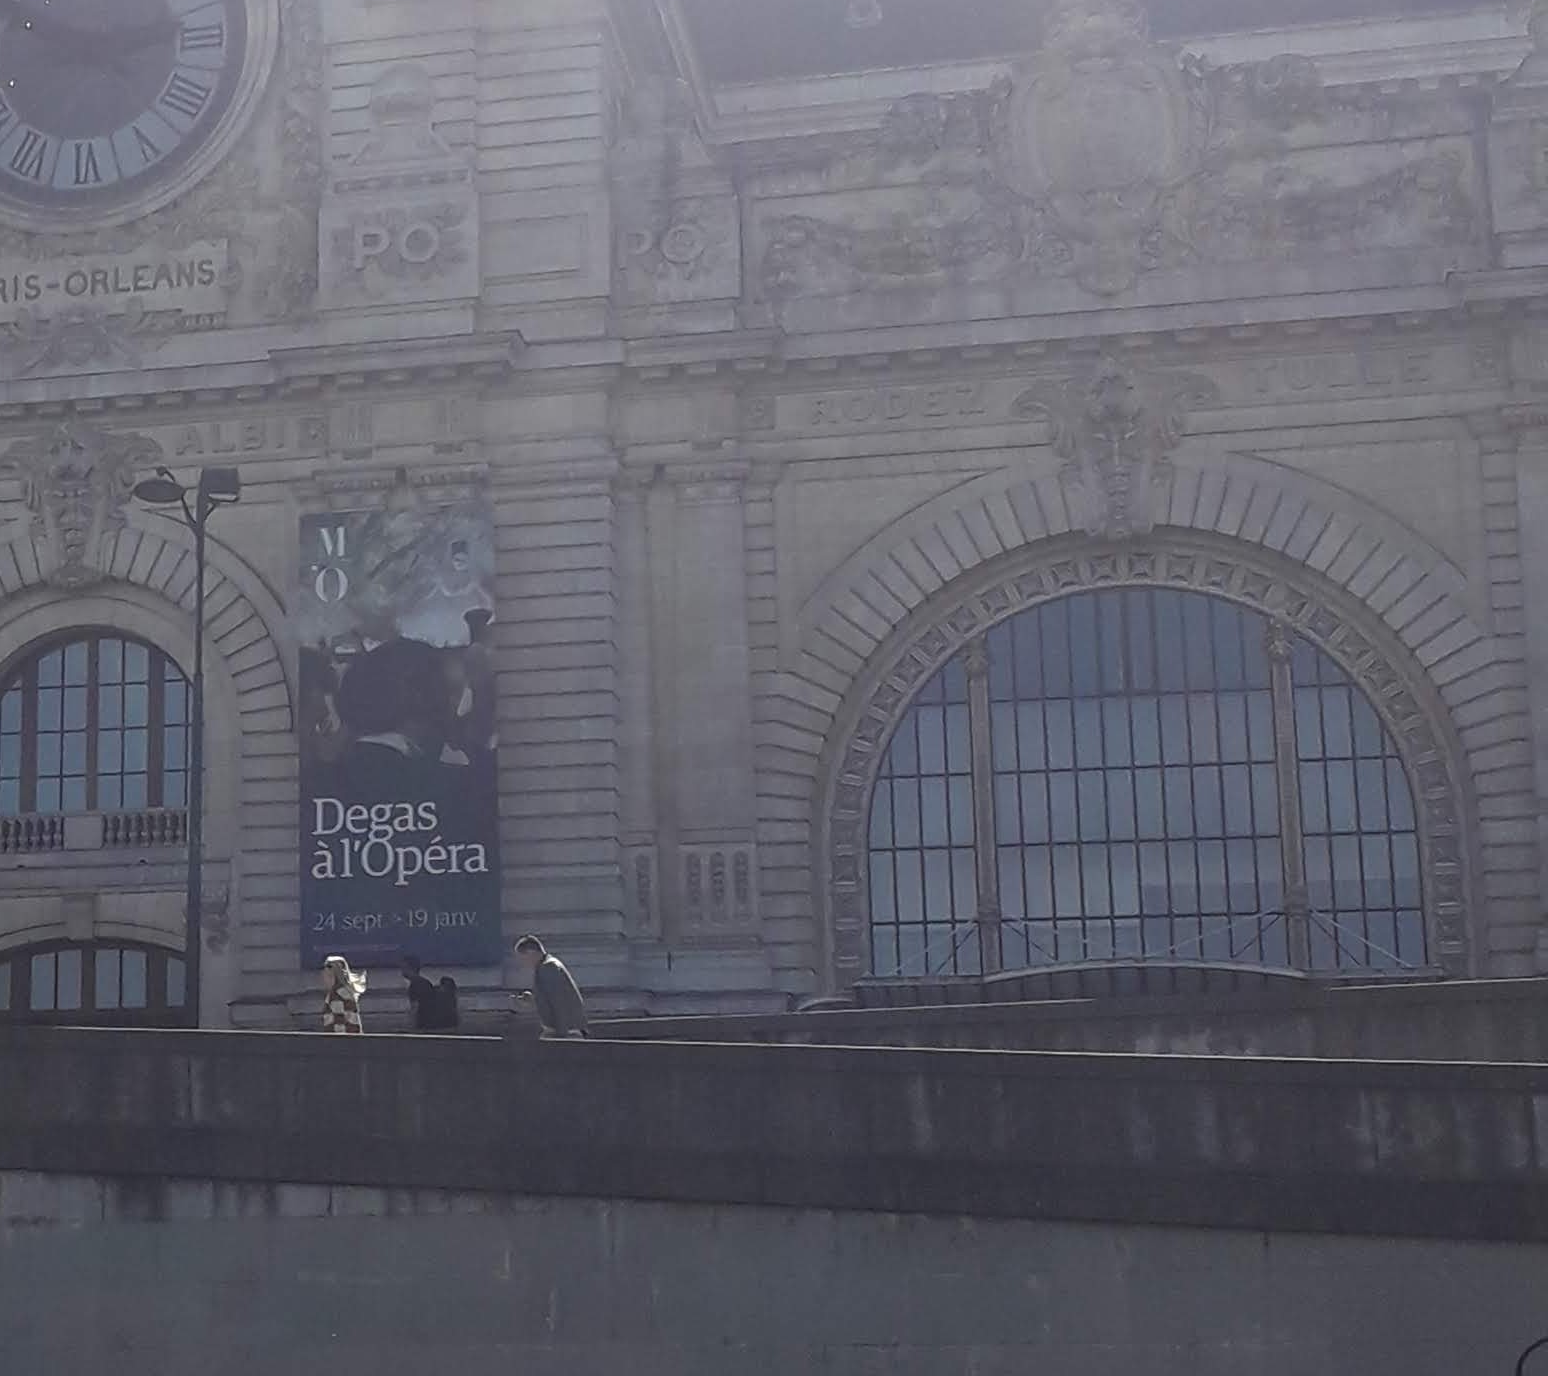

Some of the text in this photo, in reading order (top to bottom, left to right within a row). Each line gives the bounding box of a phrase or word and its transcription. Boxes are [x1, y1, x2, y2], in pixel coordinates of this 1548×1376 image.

[180, 23, 223, 49] III
[11, 130, 48, 180] VII
[74, 142, 102, 184] VI
[354, 223, 440, 268] PO
[311, 797, 438, 841] Degas
[313, 912, 335, 931] 24
